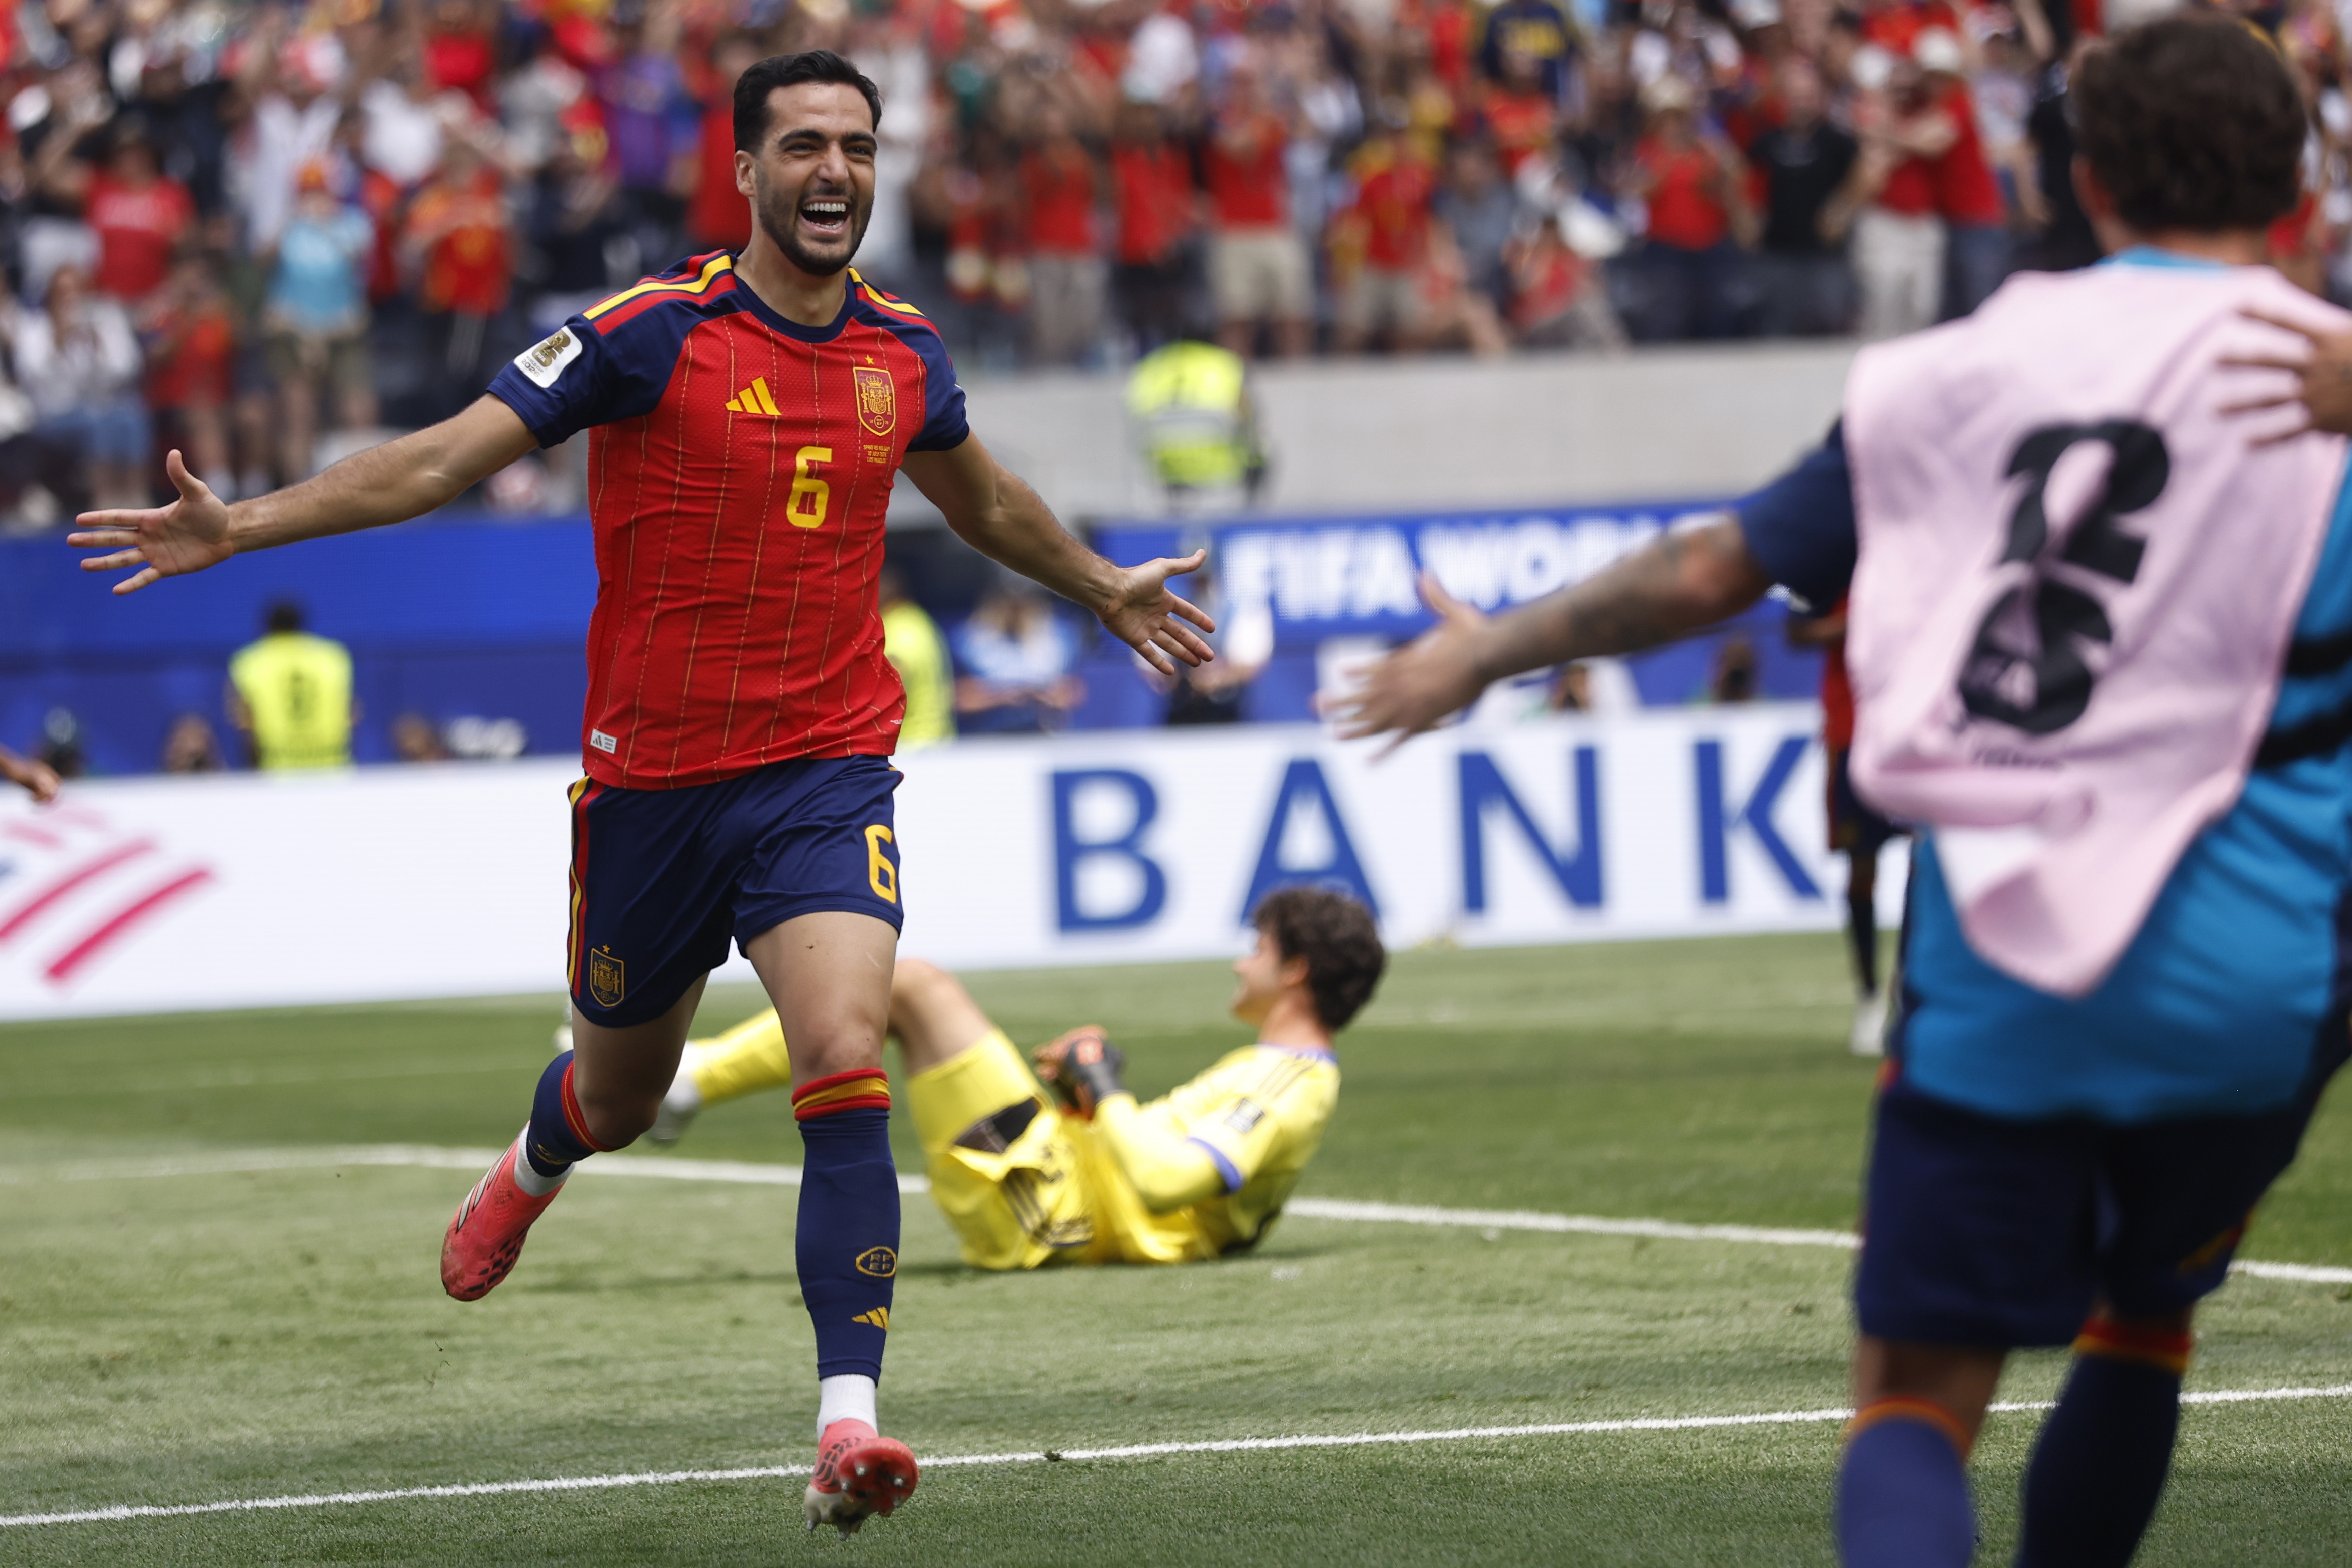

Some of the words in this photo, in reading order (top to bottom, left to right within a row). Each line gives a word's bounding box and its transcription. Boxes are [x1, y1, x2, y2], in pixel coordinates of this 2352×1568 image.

[521, 359, 540, 378] 2026
[535, 351, 546, 363] FIFA
[786, 445, 832, 529] 6
[1222, 526, 1423, 621] FIFA
[1416, 513, 1729, 611] WOR
[864, 824, 897, 904] 6
[1051, 735, 1824, 933] BANK
